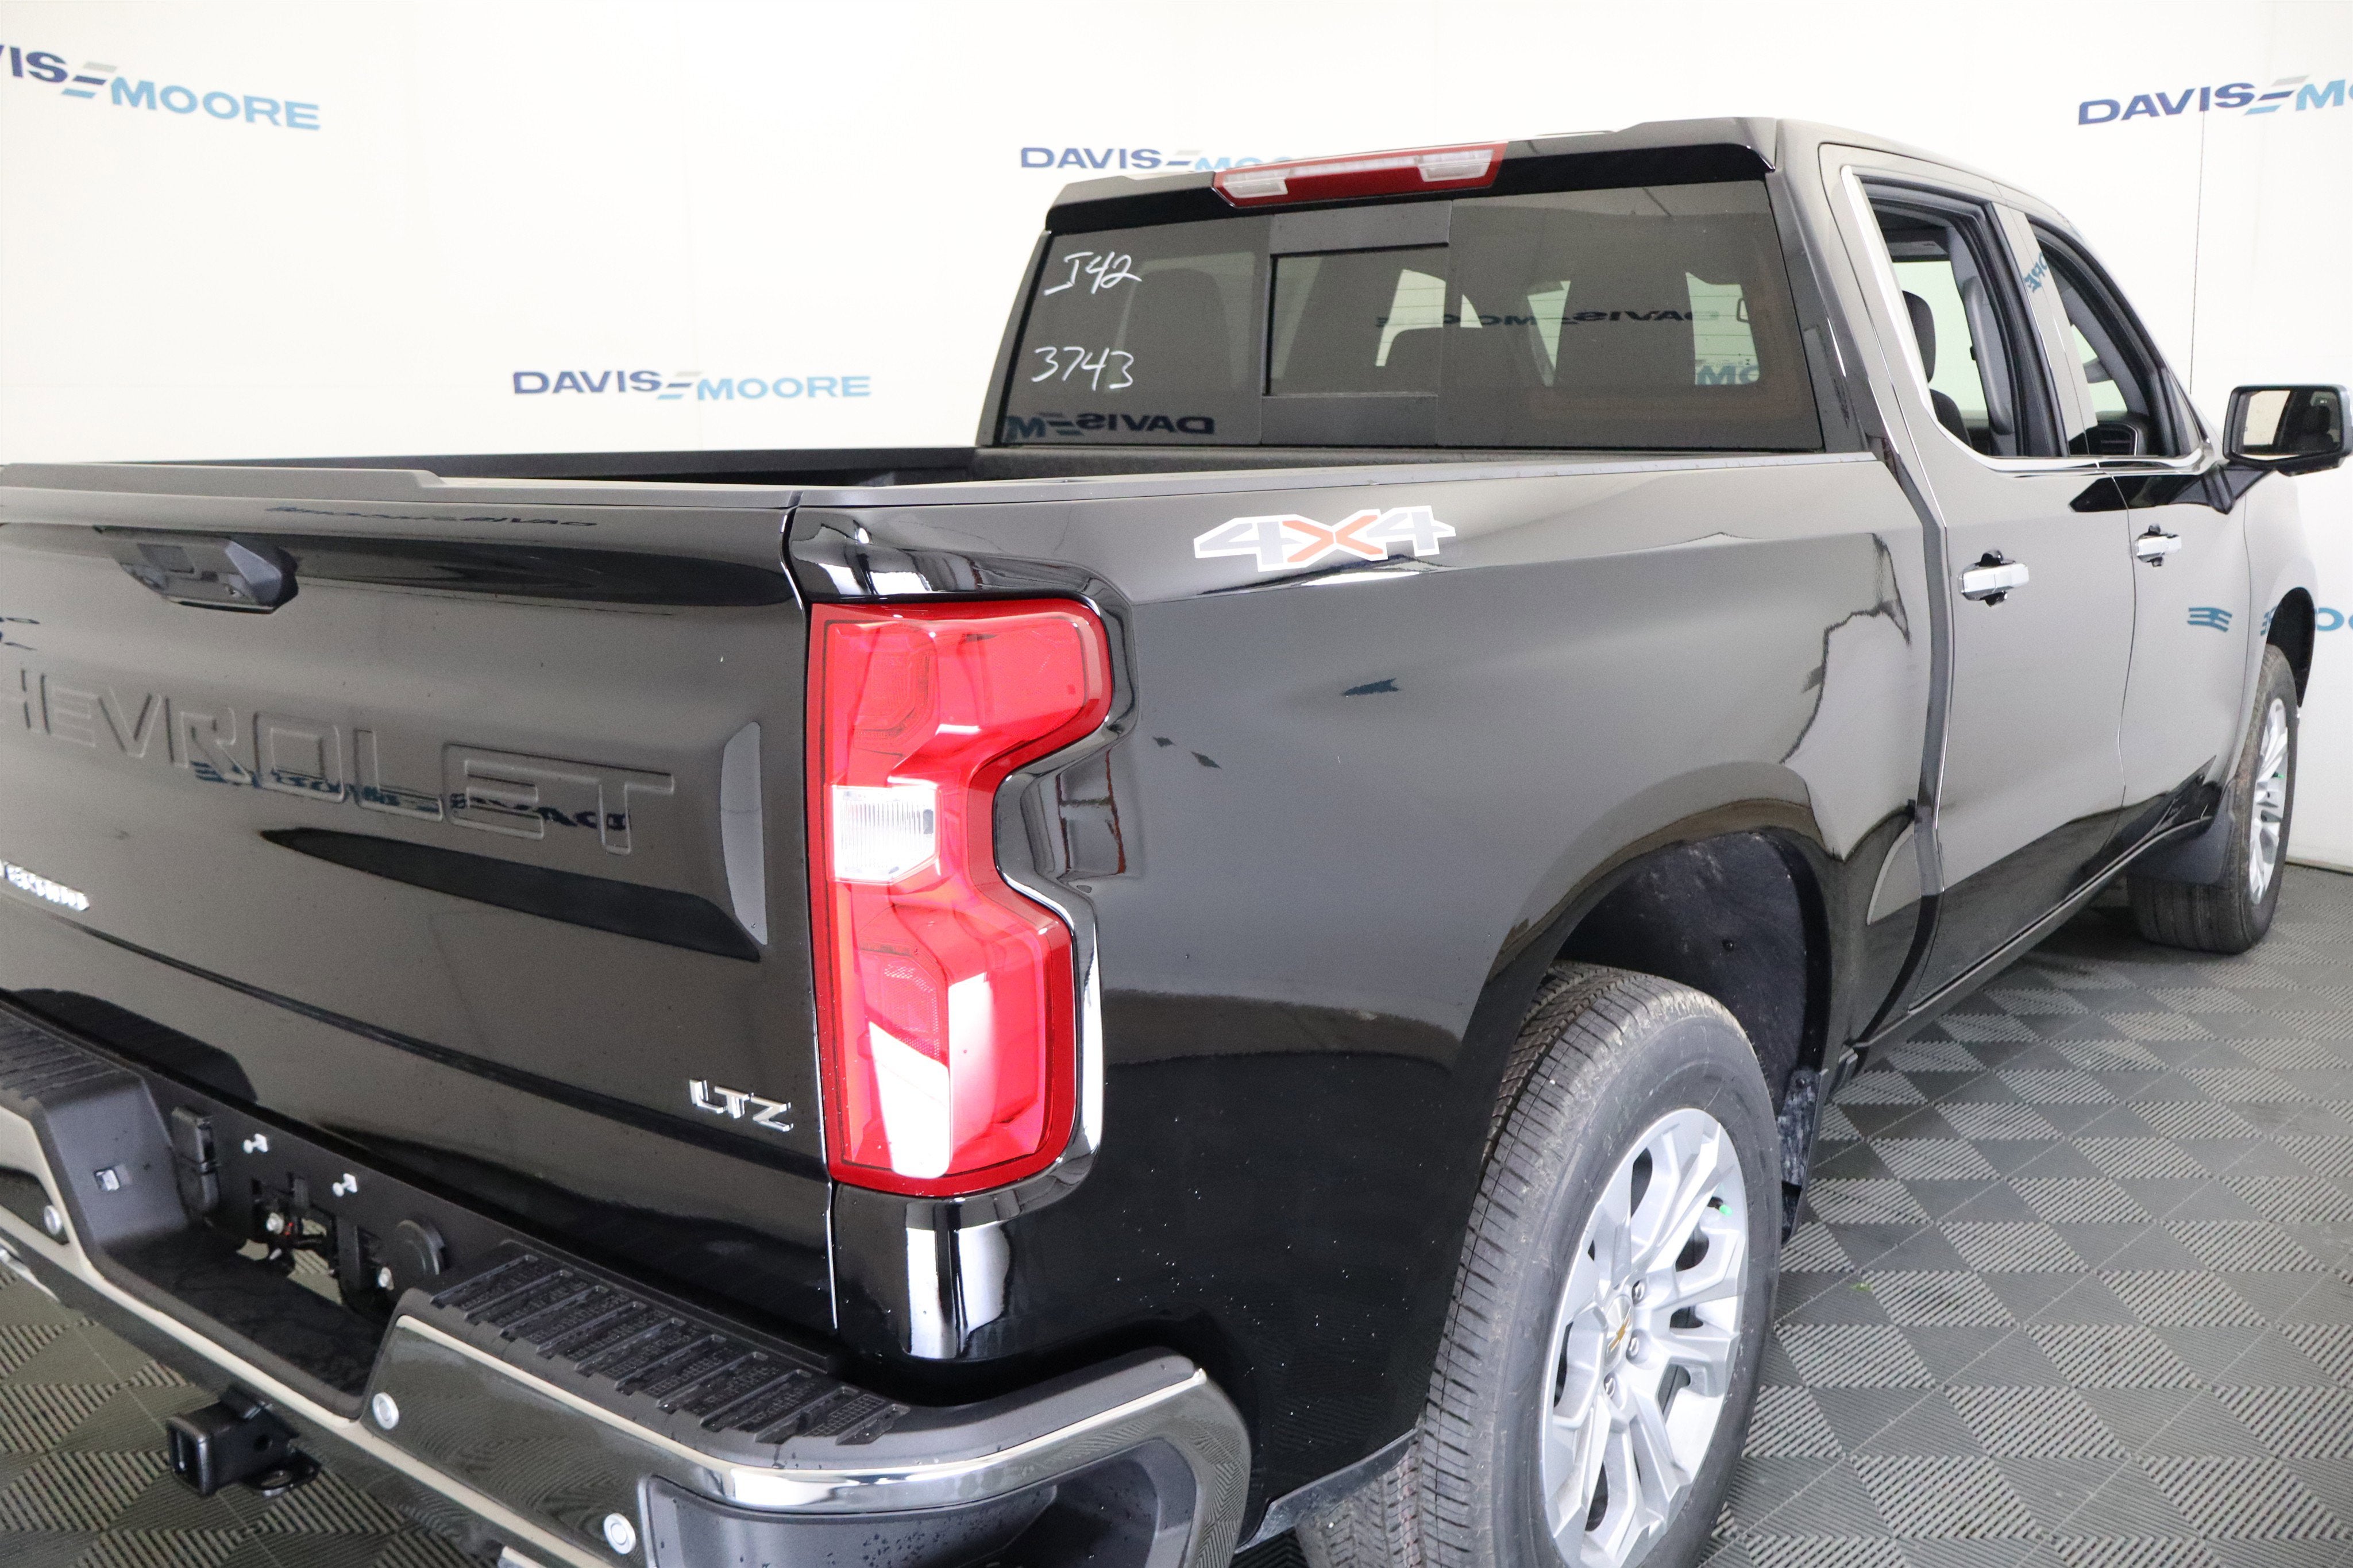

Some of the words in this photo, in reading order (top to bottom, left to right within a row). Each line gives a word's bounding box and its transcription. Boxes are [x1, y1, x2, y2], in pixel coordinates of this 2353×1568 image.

[0, 44, 68, 83] IS
[111, 76, 321, 130] MOORE
[2078, 82, 2256, 125] DAVIS
[1021, 147, 1162, 169] DAVIS
[513, 370, 663, 395] DAVIS
[697, 376, 871, 401] MOORE
[1031, 346, 1134, 391] 3743
[1194, 505, 1456, 572] 4X4
[689, 1079, 794, 1132] LTZ
